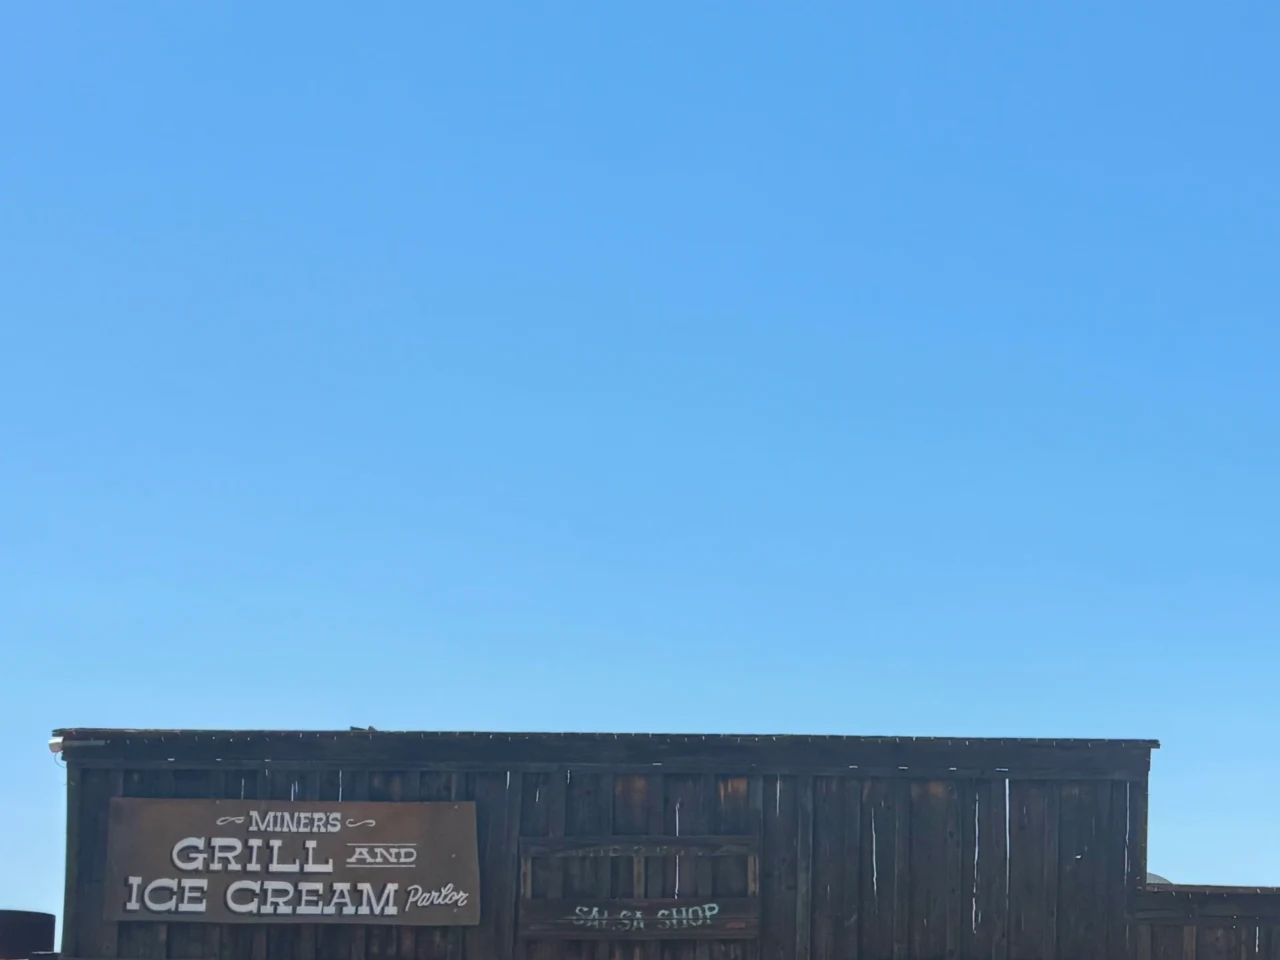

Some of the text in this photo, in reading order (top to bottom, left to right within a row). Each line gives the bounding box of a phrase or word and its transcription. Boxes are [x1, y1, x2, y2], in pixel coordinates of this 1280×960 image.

[248, 810, 342, 833] MINER'S
[171, 837, 417, 873] GRILL AND
[124, 876, 470, 916] ICE CREAM Parlor
[656, 902, 720, 930] SHOP
